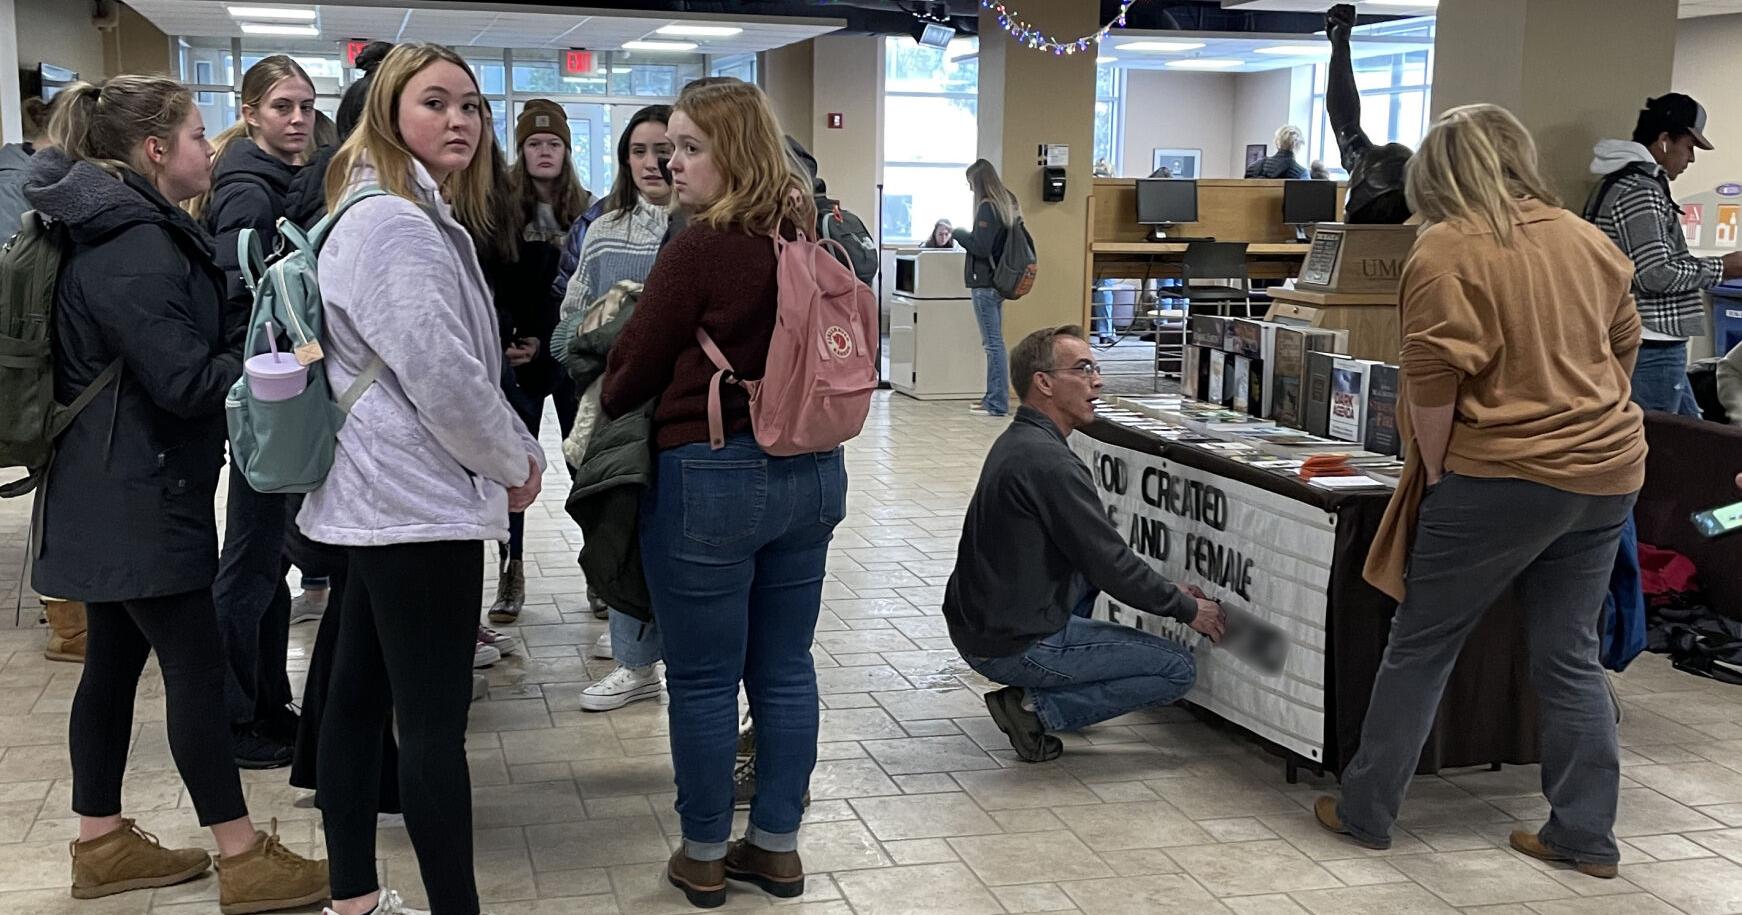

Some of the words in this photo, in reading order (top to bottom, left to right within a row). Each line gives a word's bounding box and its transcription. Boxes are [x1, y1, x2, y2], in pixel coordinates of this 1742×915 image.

[567, 51, 592, 73] EXIT
[1141, 466, 1228, 531] CREATED
[1129, 513, 1170, 562] AND
[1185, 532, 1254, 602] FEMALE
